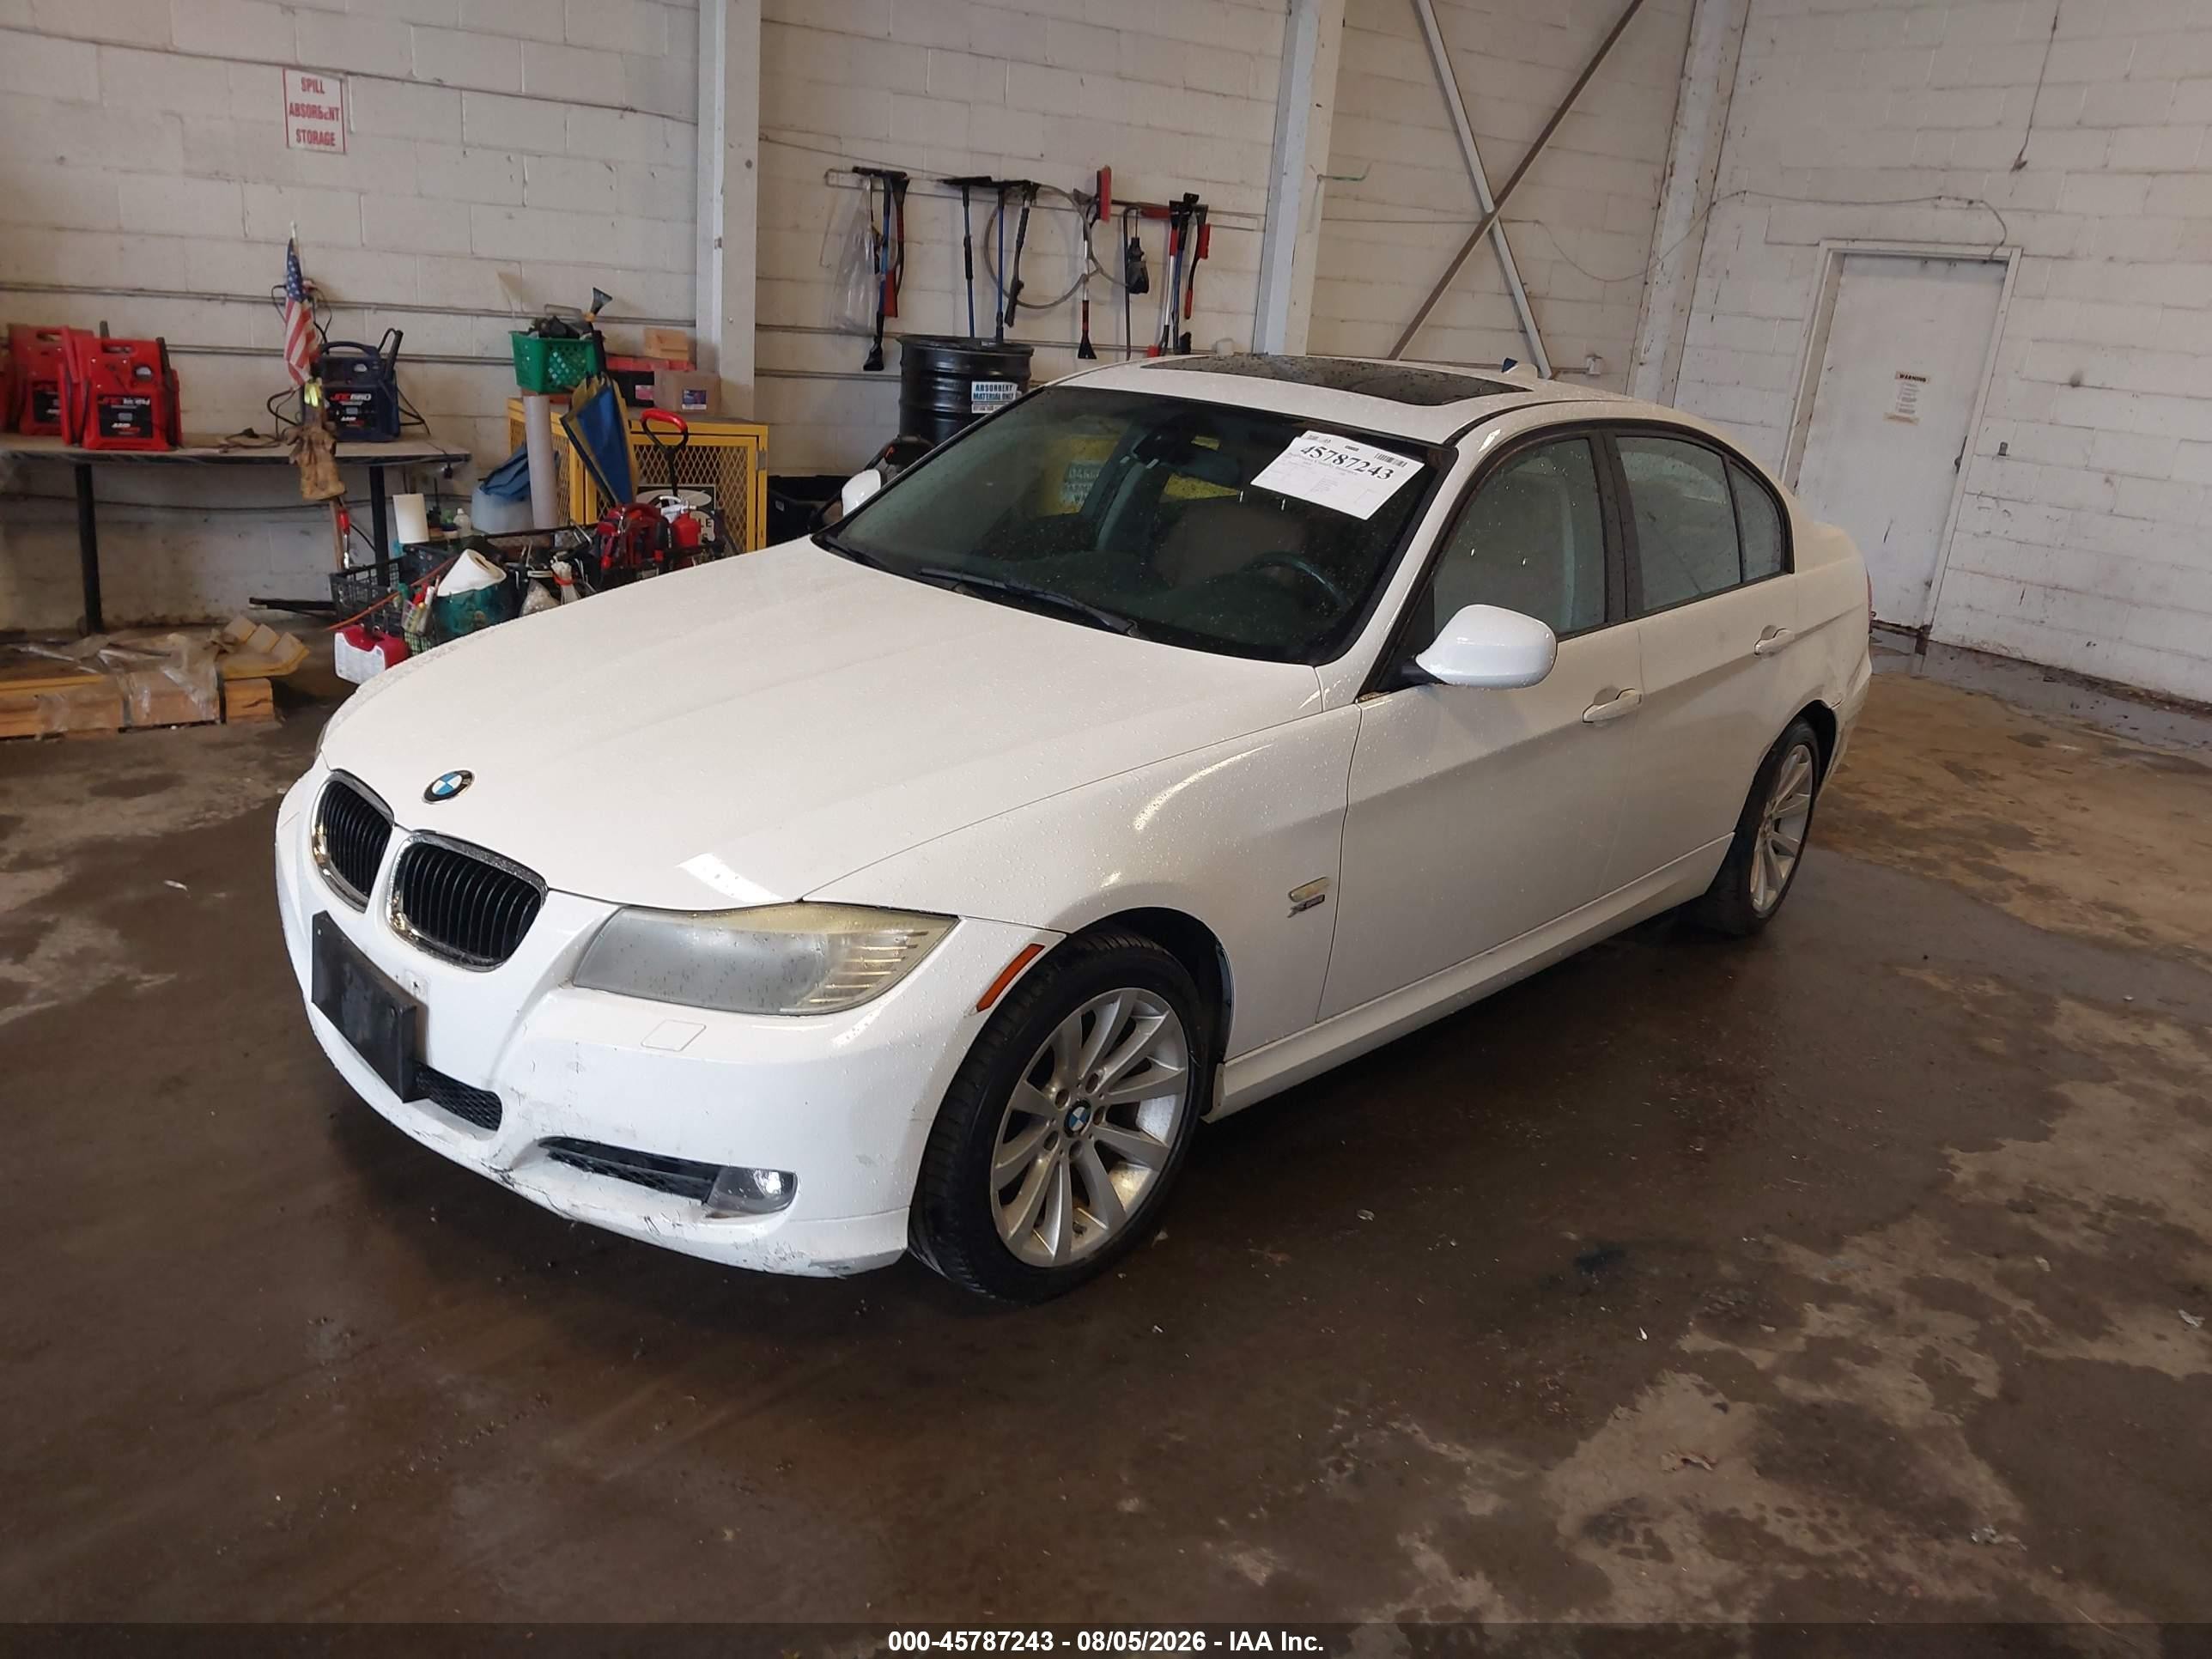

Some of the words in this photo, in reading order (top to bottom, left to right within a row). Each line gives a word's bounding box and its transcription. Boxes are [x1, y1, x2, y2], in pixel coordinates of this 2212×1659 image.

[301, 76, 325, 94] SPILL
[295, 128, 336, 147] STORAGE
[975, 384, 1013, 392] ABSORBENT
[1300, 446, 1394, 480] 45787243
